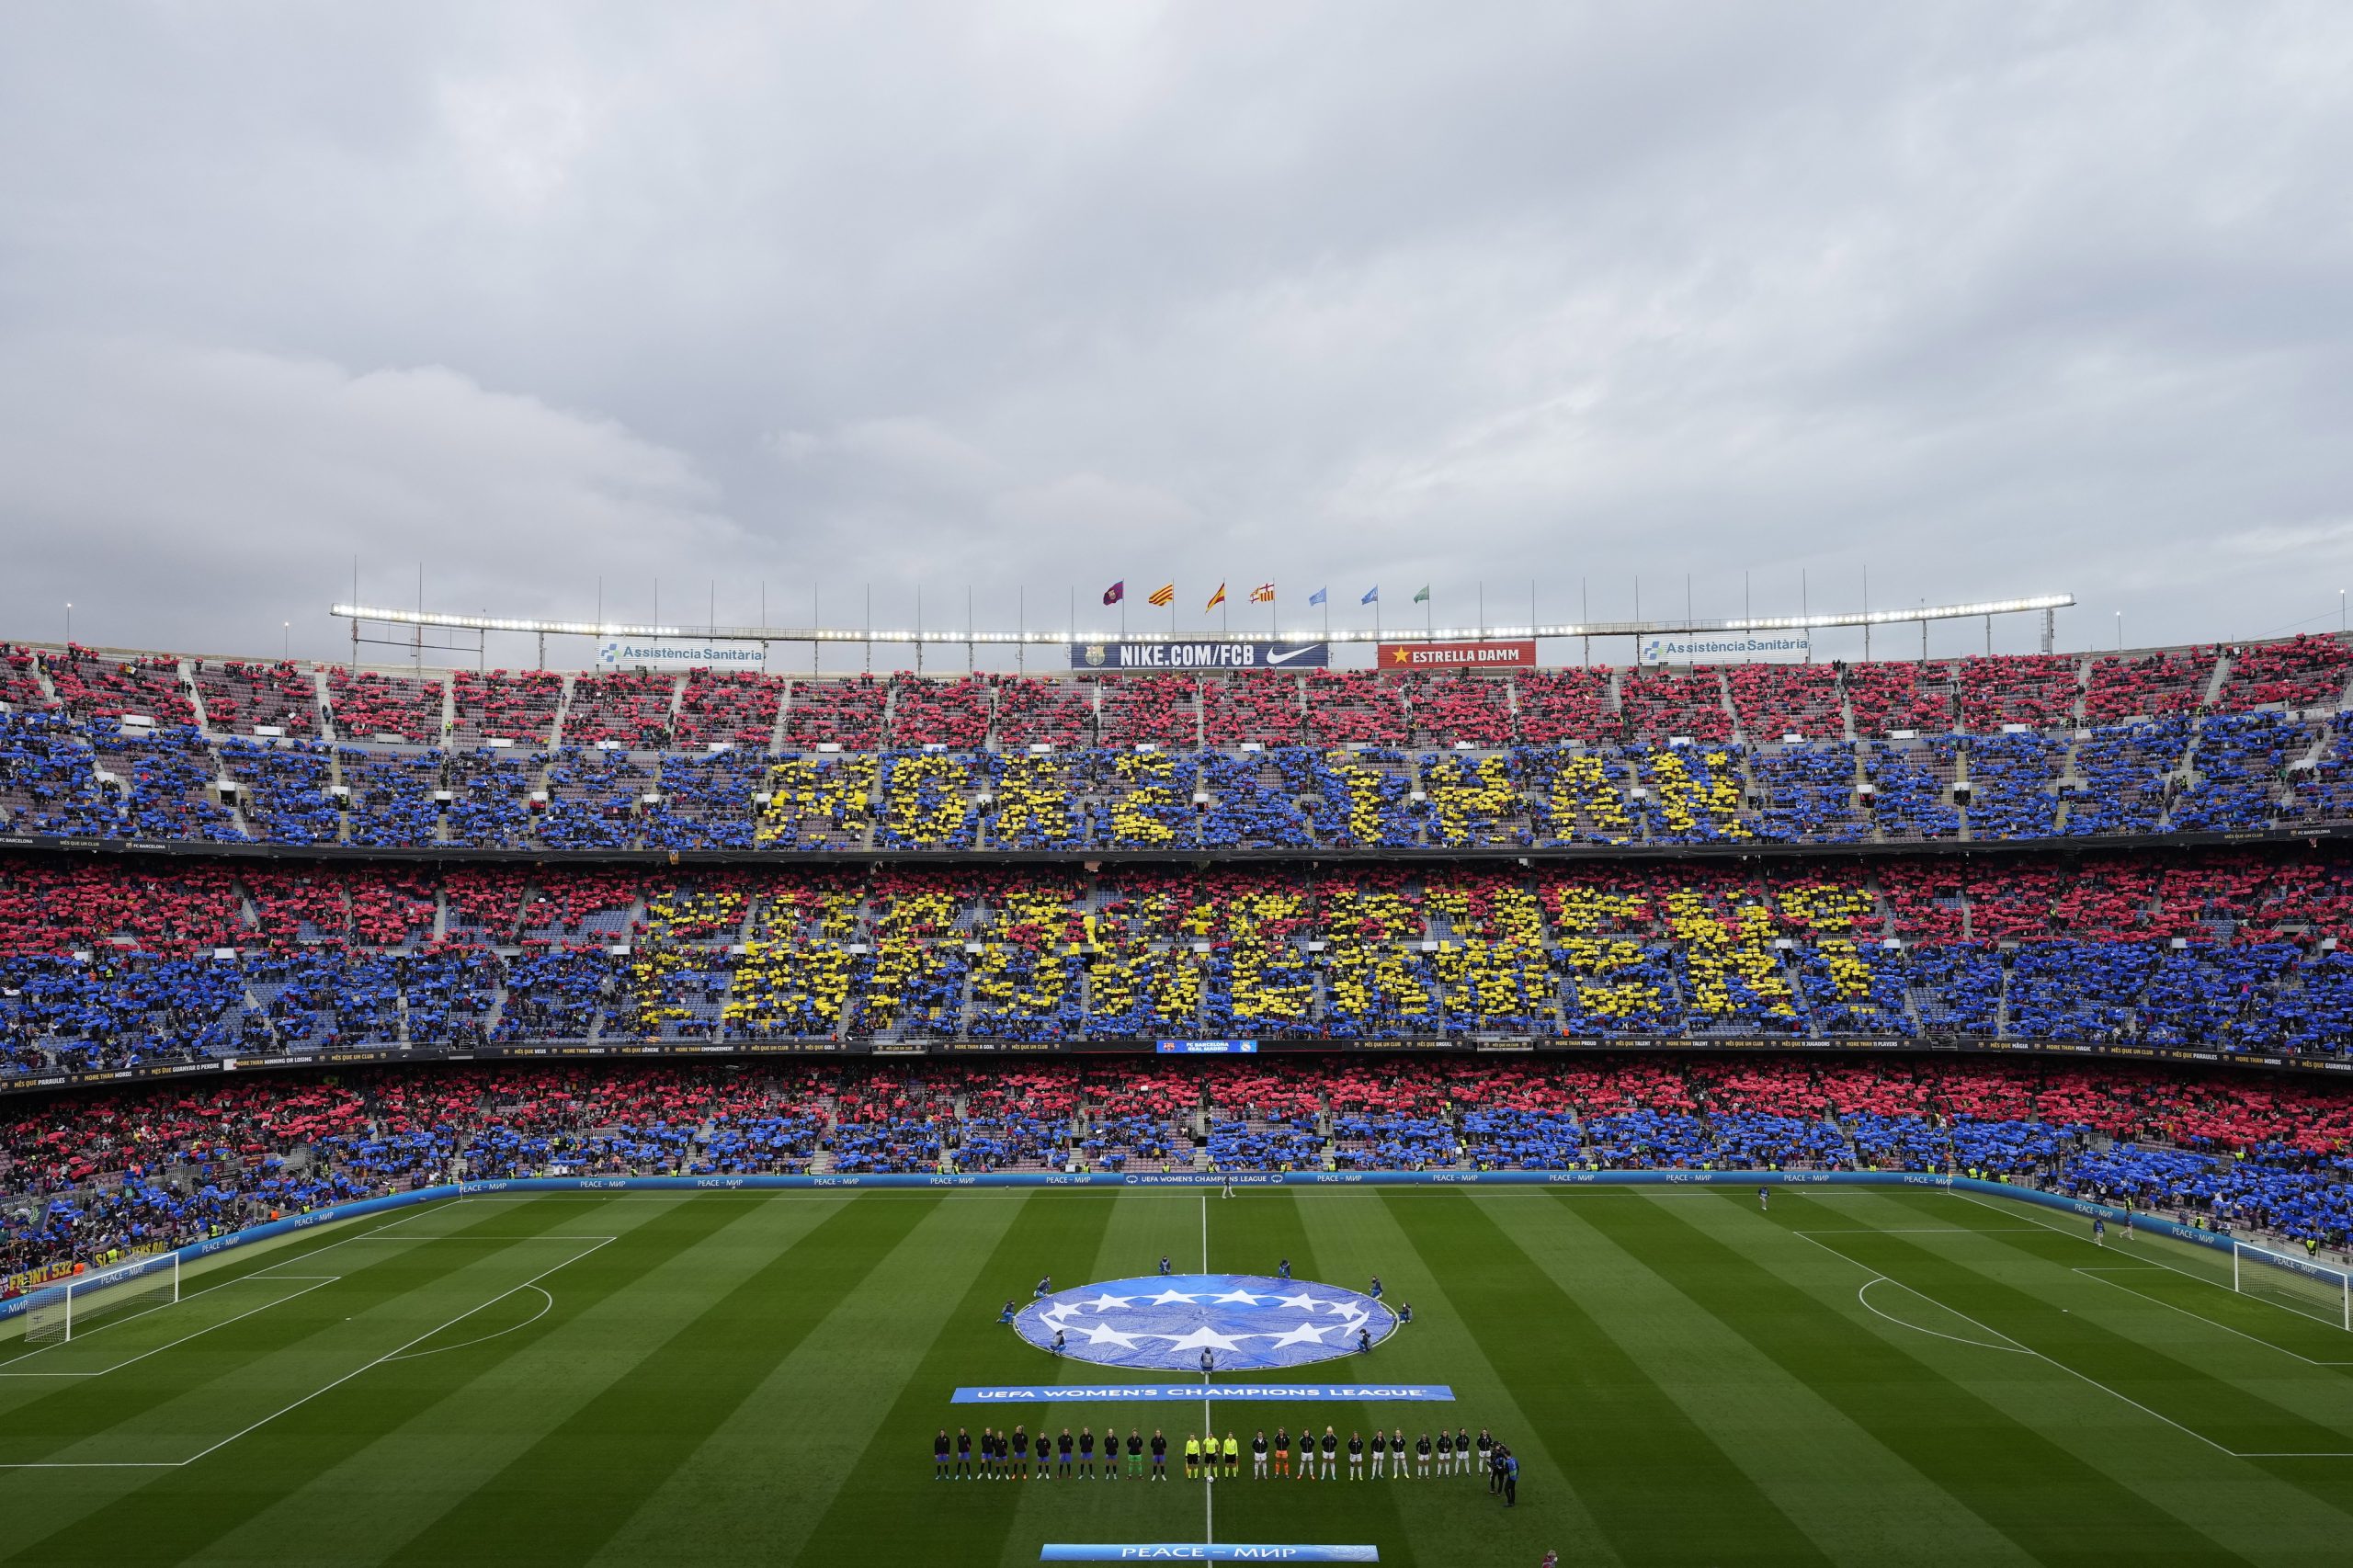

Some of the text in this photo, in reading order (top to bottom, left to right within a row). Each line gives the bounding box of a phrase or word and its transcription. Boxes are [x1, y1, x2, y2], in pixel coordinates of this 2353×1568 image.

[1666, 639, 1808, 653] Assistència Sanitària
[623, 646, 762, 660] Assistència Sanitària
[1120, 645, 1254, 665] NIKE.COM/FCB
[1413, 650, 1518, 662] ESTRELLA DAMM
[460, 1185, 482, 1193] PEACE
[2075, 1203, 2094, 1213] PEACE
[294, 1218, 313, 1226] PEACE
[2173, 1228, 2192, 1238] PEACE
[202, 1243, 221, 1253] PEACE
[2274, 1256, 2294, 1267] PEACE
[51, 1261, 72, 1278] 532
[101, 1273, 123, 1284] PEACE
[1122, 1548, 1296, 1557] PEACE МИР
